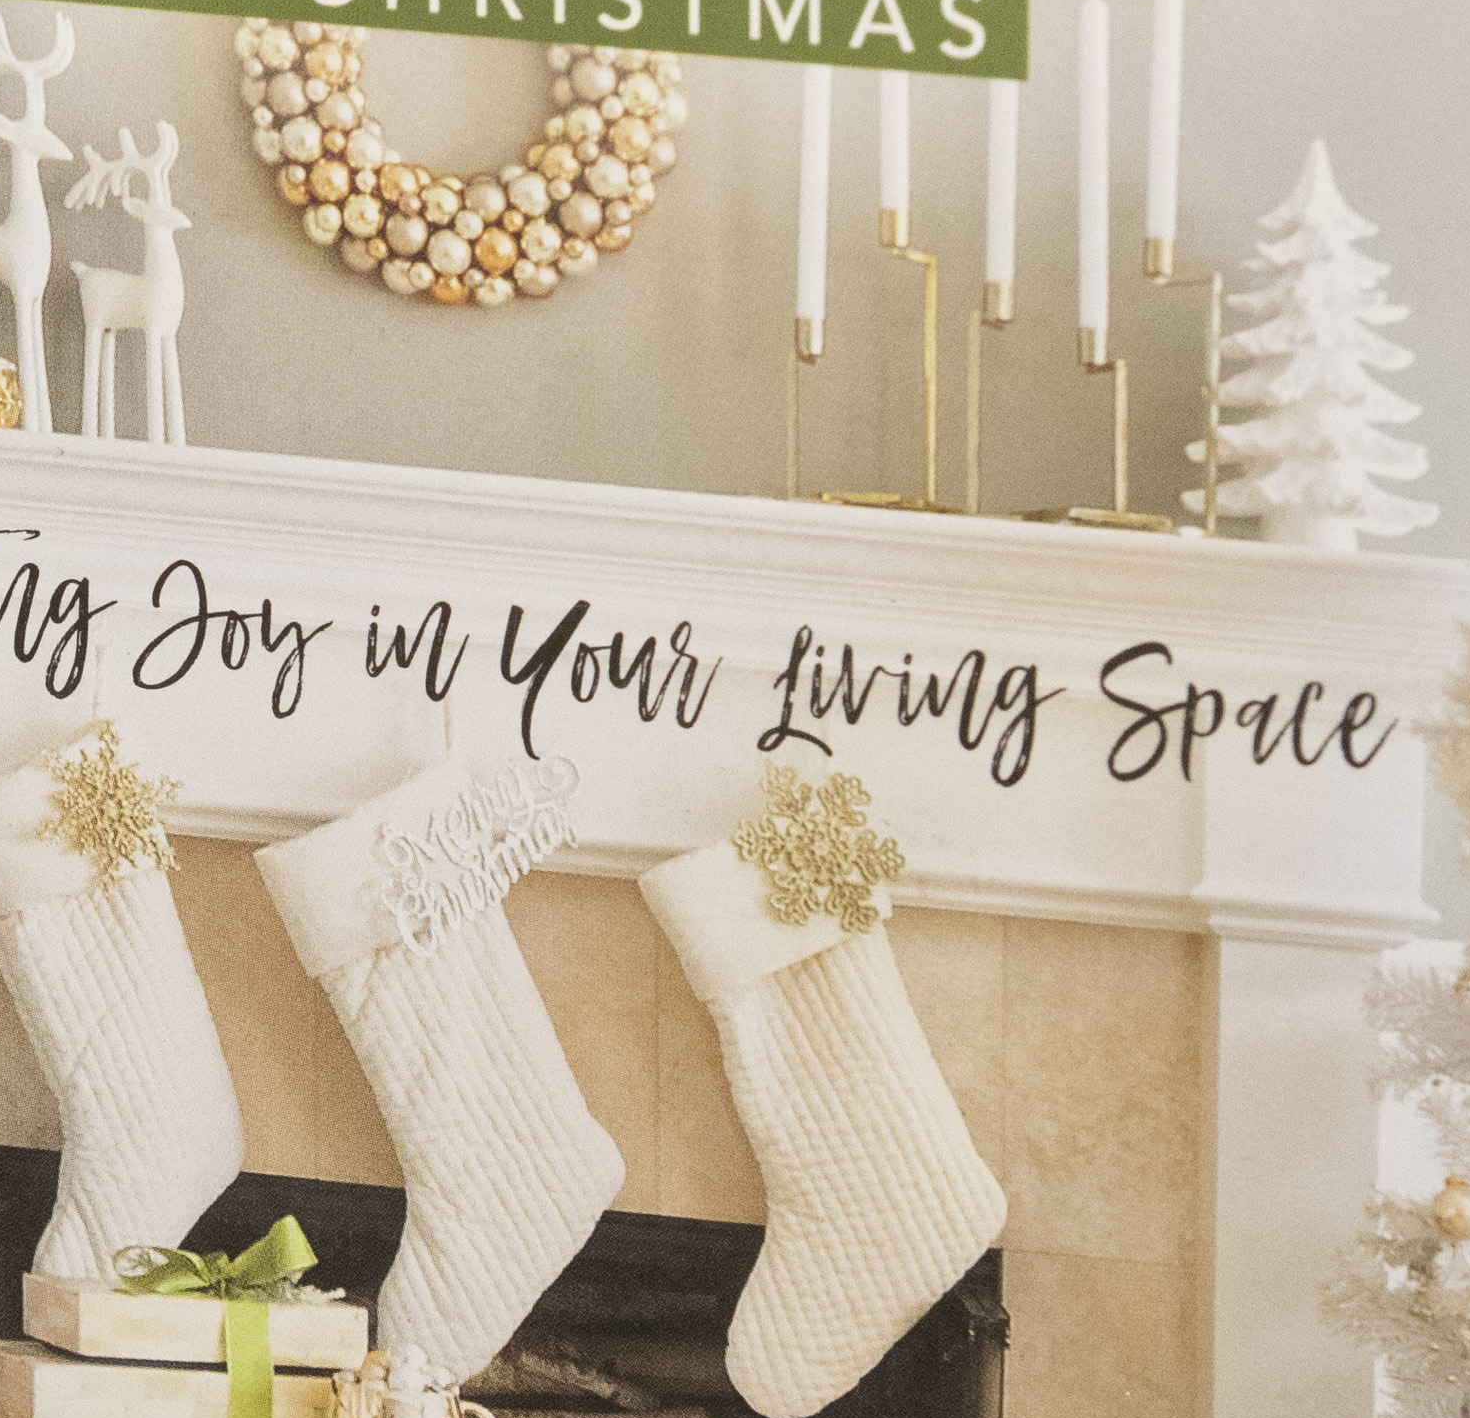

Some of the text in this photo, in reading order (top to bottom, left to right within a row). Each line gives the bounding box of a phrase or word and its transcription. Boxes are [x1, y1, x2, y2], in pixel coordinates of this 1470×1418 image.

[132, 559, 333, 719] Joy
[365, 601, 470, 702] in
[500, 599, 724, 761] Your
[757, 624, 1064, 788] Living
[1100, 642, 1401, 782] Space
